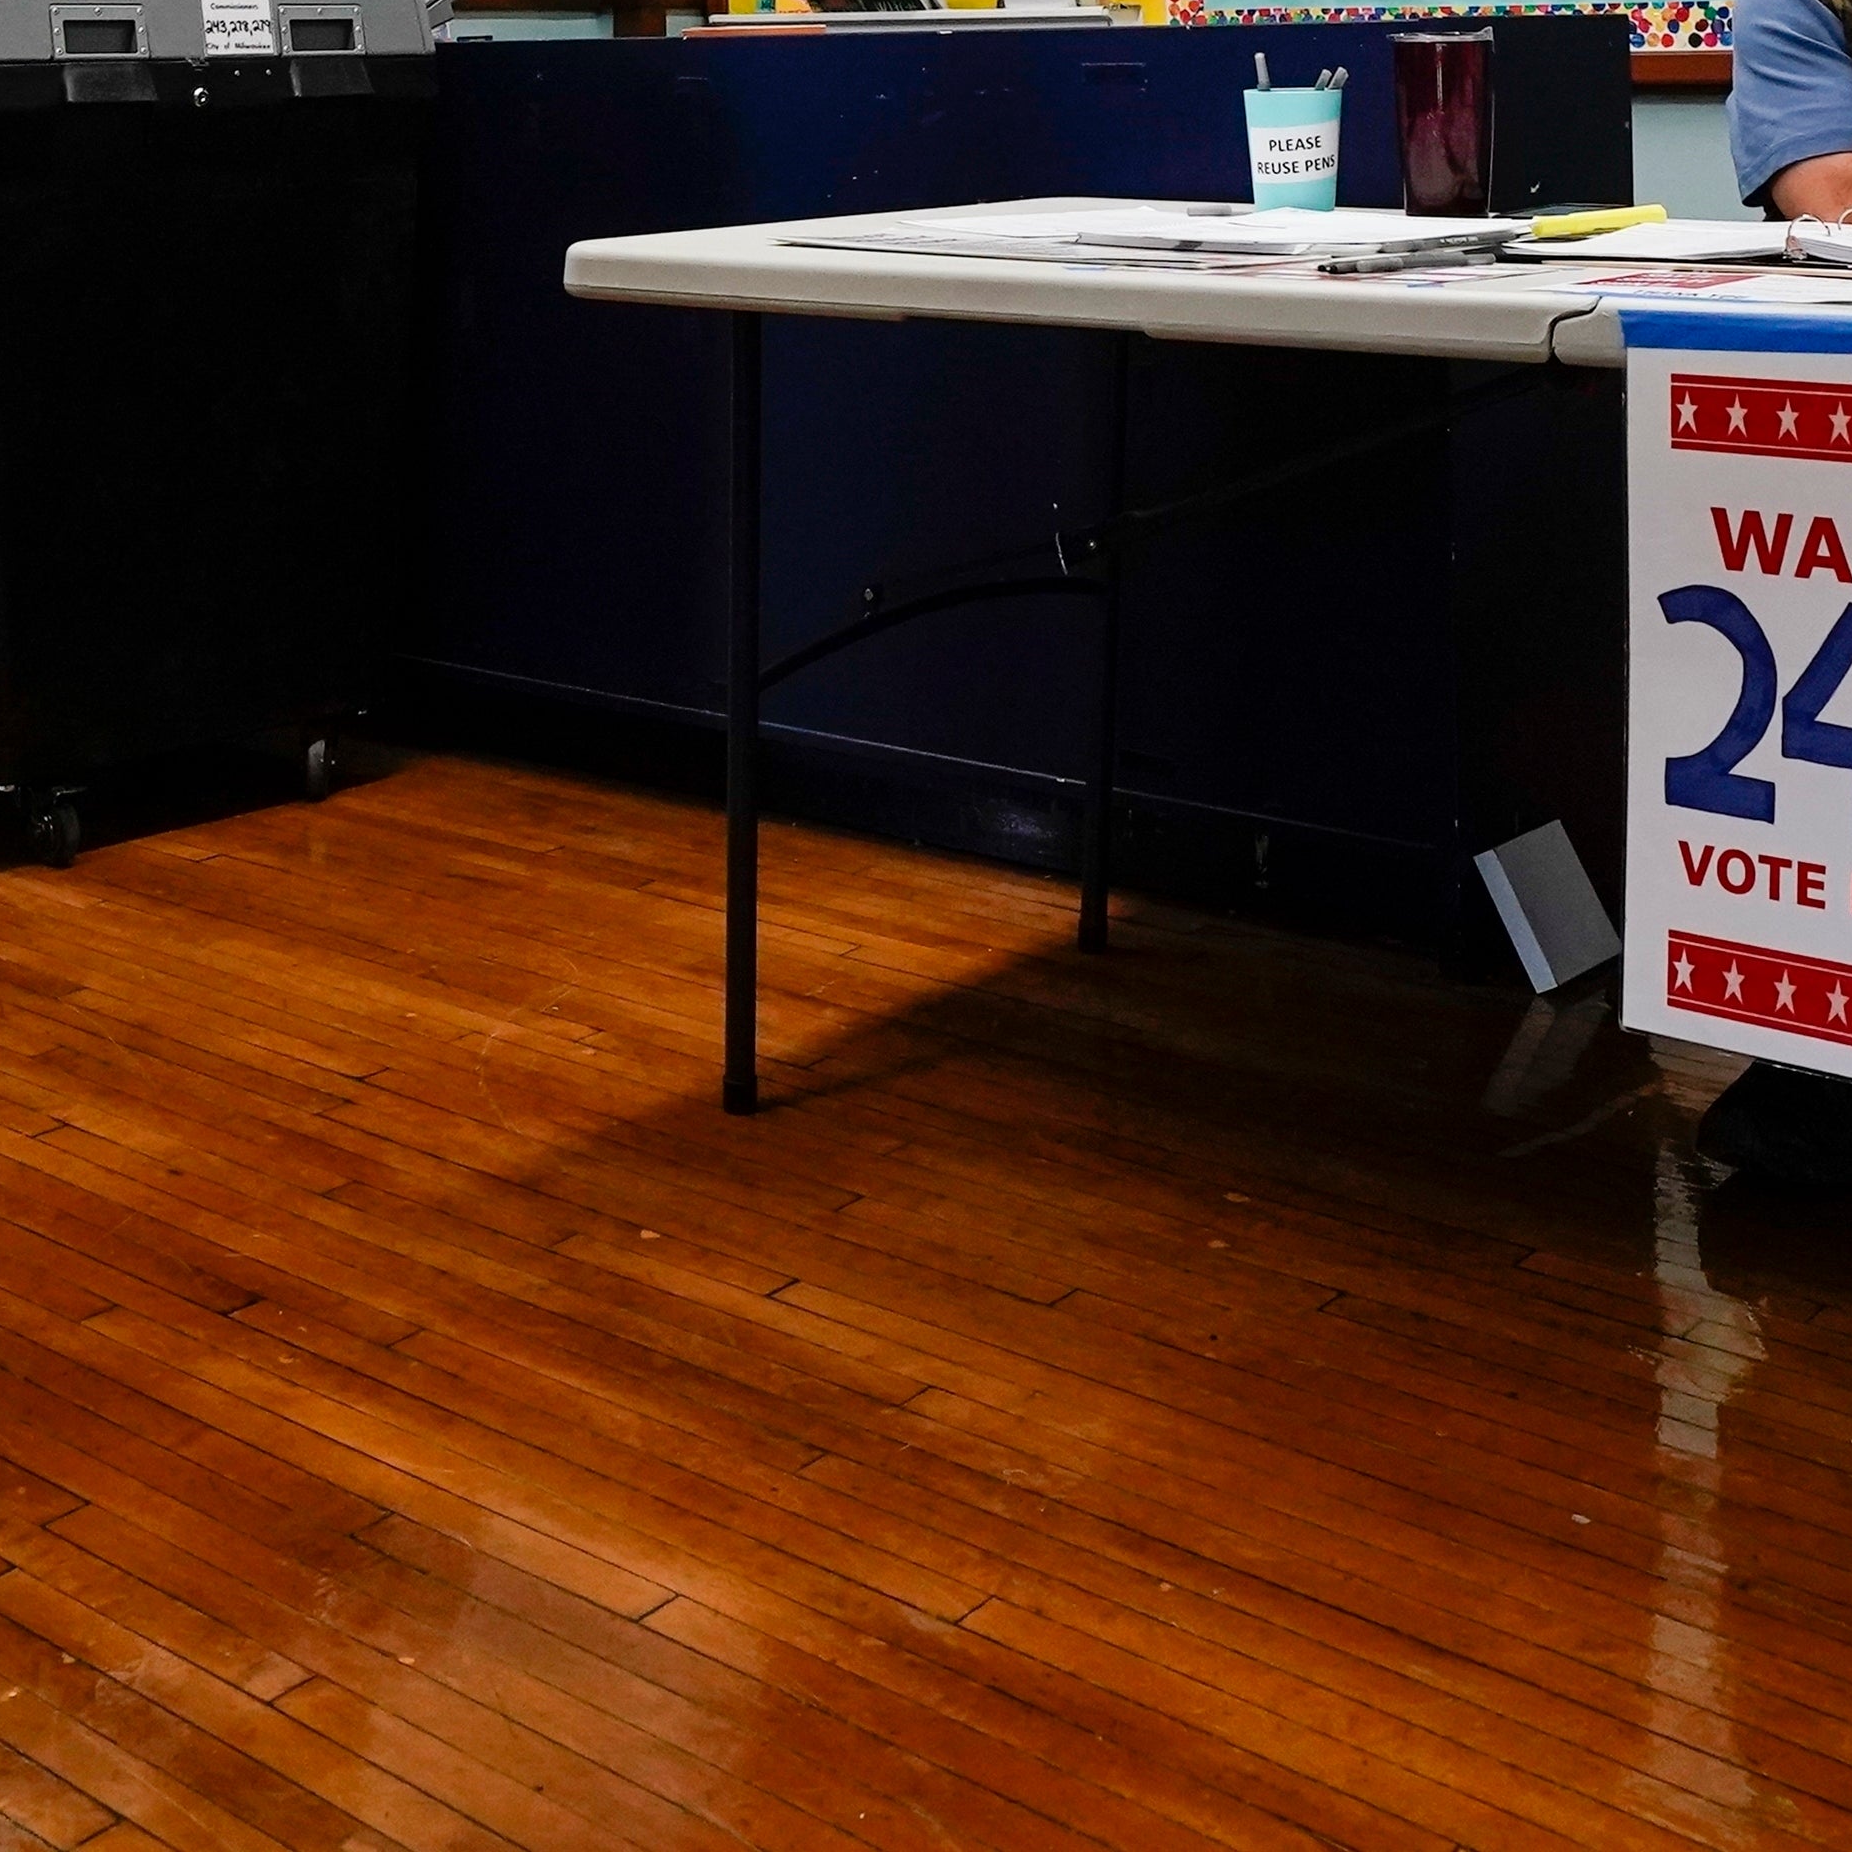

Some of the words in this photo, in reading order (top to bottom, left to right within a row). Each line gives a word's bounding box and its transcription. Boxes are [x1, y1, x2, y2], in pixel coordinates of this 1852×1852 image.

[1269, 136, 1322, 152] PLEASE
[1258, 161, 1299, 174] REUSE
[1305, 154, 1335, 172] PENS
[1677, 839, 1827, 911] VOTE
